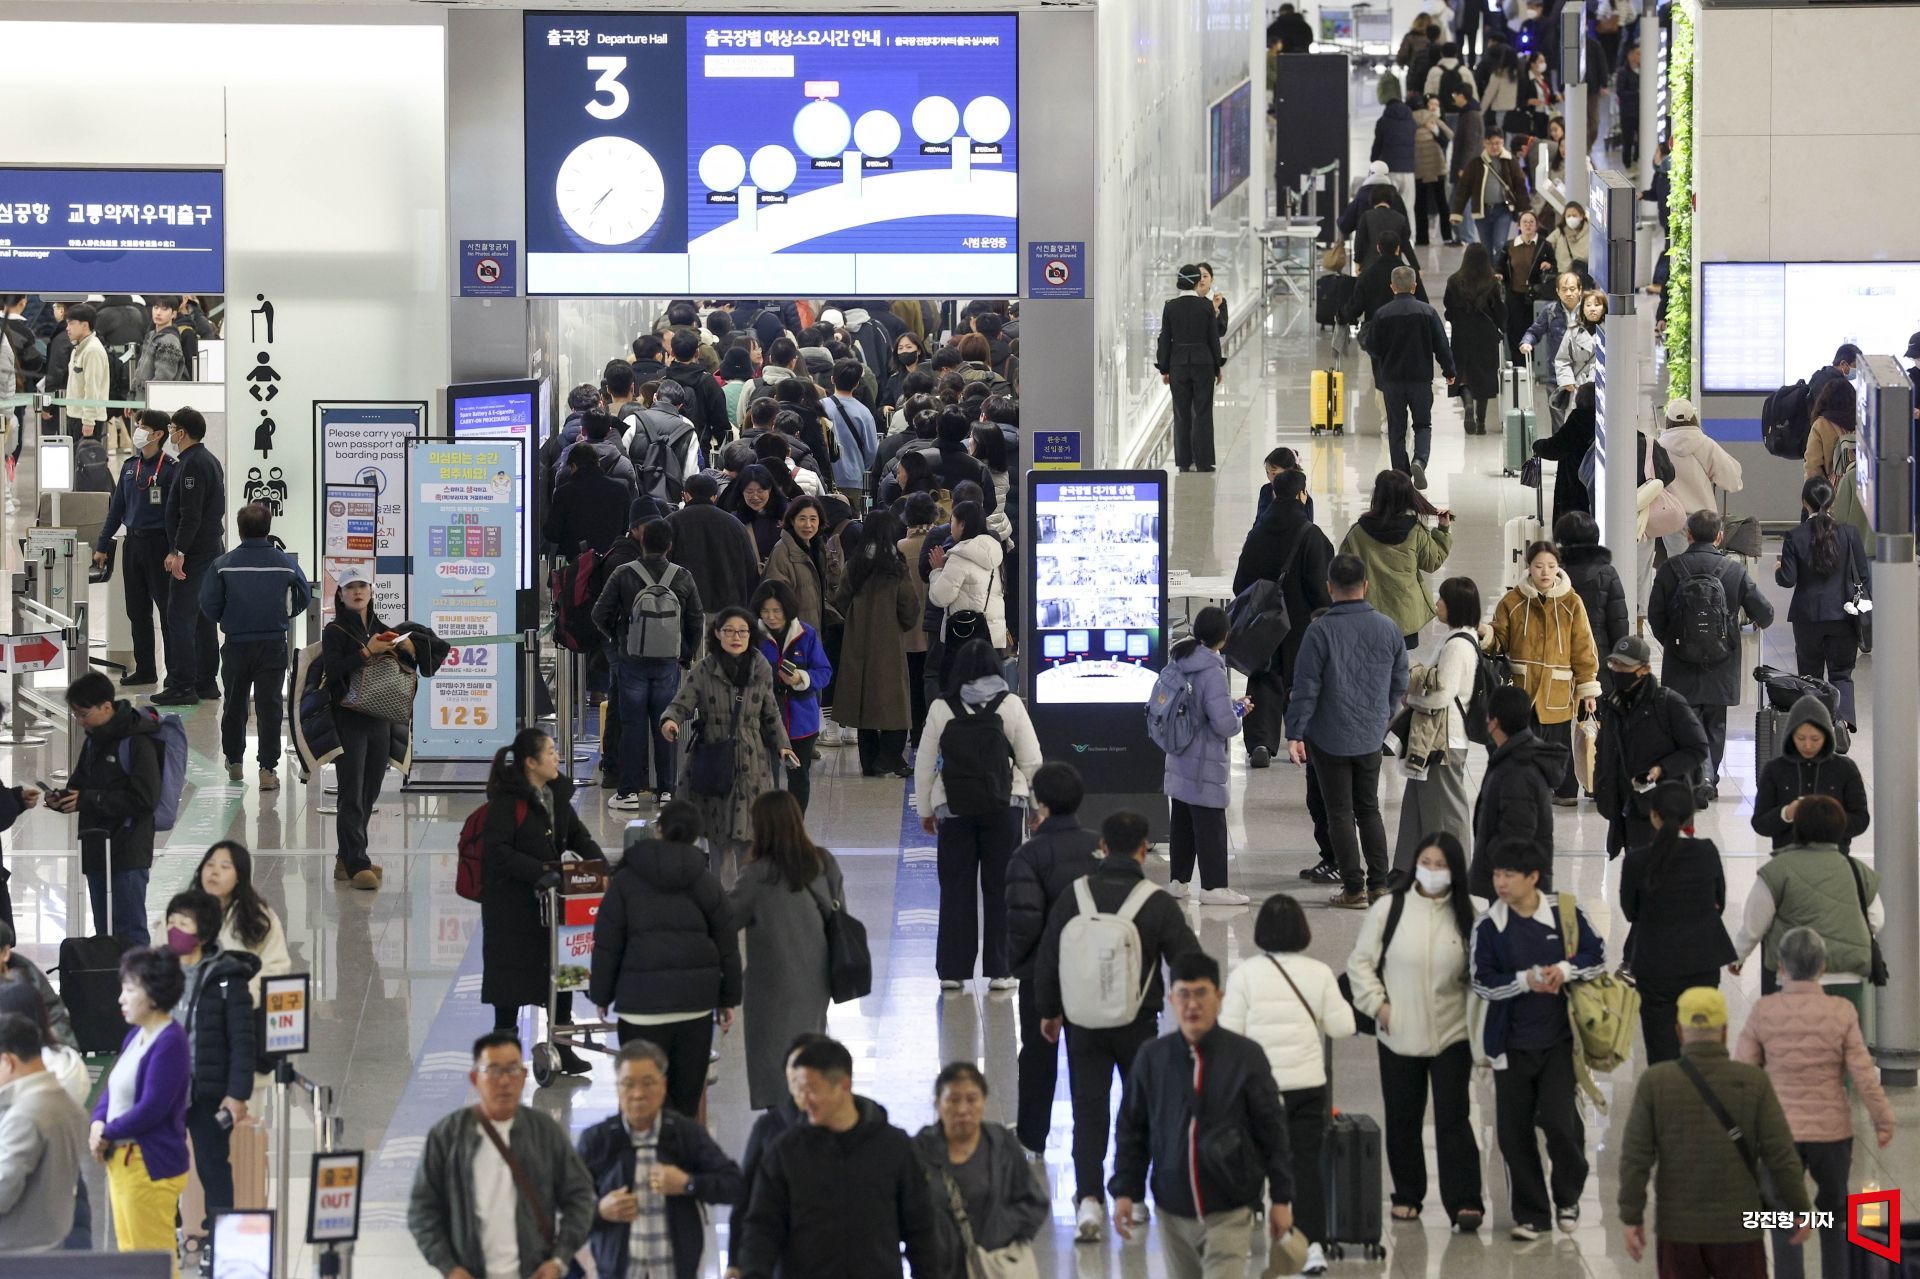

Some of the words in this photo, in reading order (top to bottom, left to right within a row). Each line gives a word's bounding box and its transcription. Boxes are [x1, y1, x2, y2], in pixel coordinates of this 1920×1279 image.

[546, 29, 590, 46] 출국장
[597, 33, 648, 46] Departure
[649, 33, 668, 44] Hall
[704, 29, 762, 48] 출국장별
[764, 29, 850, 47] 예상소요시간
[852, 29, 881, 47] 안내
[584, 56, 630, 120] 3
[68, 204, 212, 225] 교통약자우대출구
[962, 237, 980, 249] 시범
[981, 237, 1008, 249] 운영중
[1035, 245, 1077, 253] 사진촬영금지
[13, 250, 50, 260] Passenger
[328, 428, 361, 437] Please
[362, 430, 389, 439] carry
[391, 430, 412, 439] your
[350, 440, 393, 450] passport
[1044, 445, 1071, 454] 진입불가
[336, 450, 379, 460] boarding
[429, 451, 472, 464] 의심되는
[476, 451, 498, 464] 순간
[440, 467, 487, 480] 멈추세요!
[451, 514, 479, 525] CARD
[378, 539, 389, 548] 요
[440, 565, 489, 575] 기억하세요!
[570, 874, 597, 884] Maxim
[571, 944, 593, 957] 여기
[278, 1014, 293, 1029] IN
[320, 1192, 352, 1210] OUT
